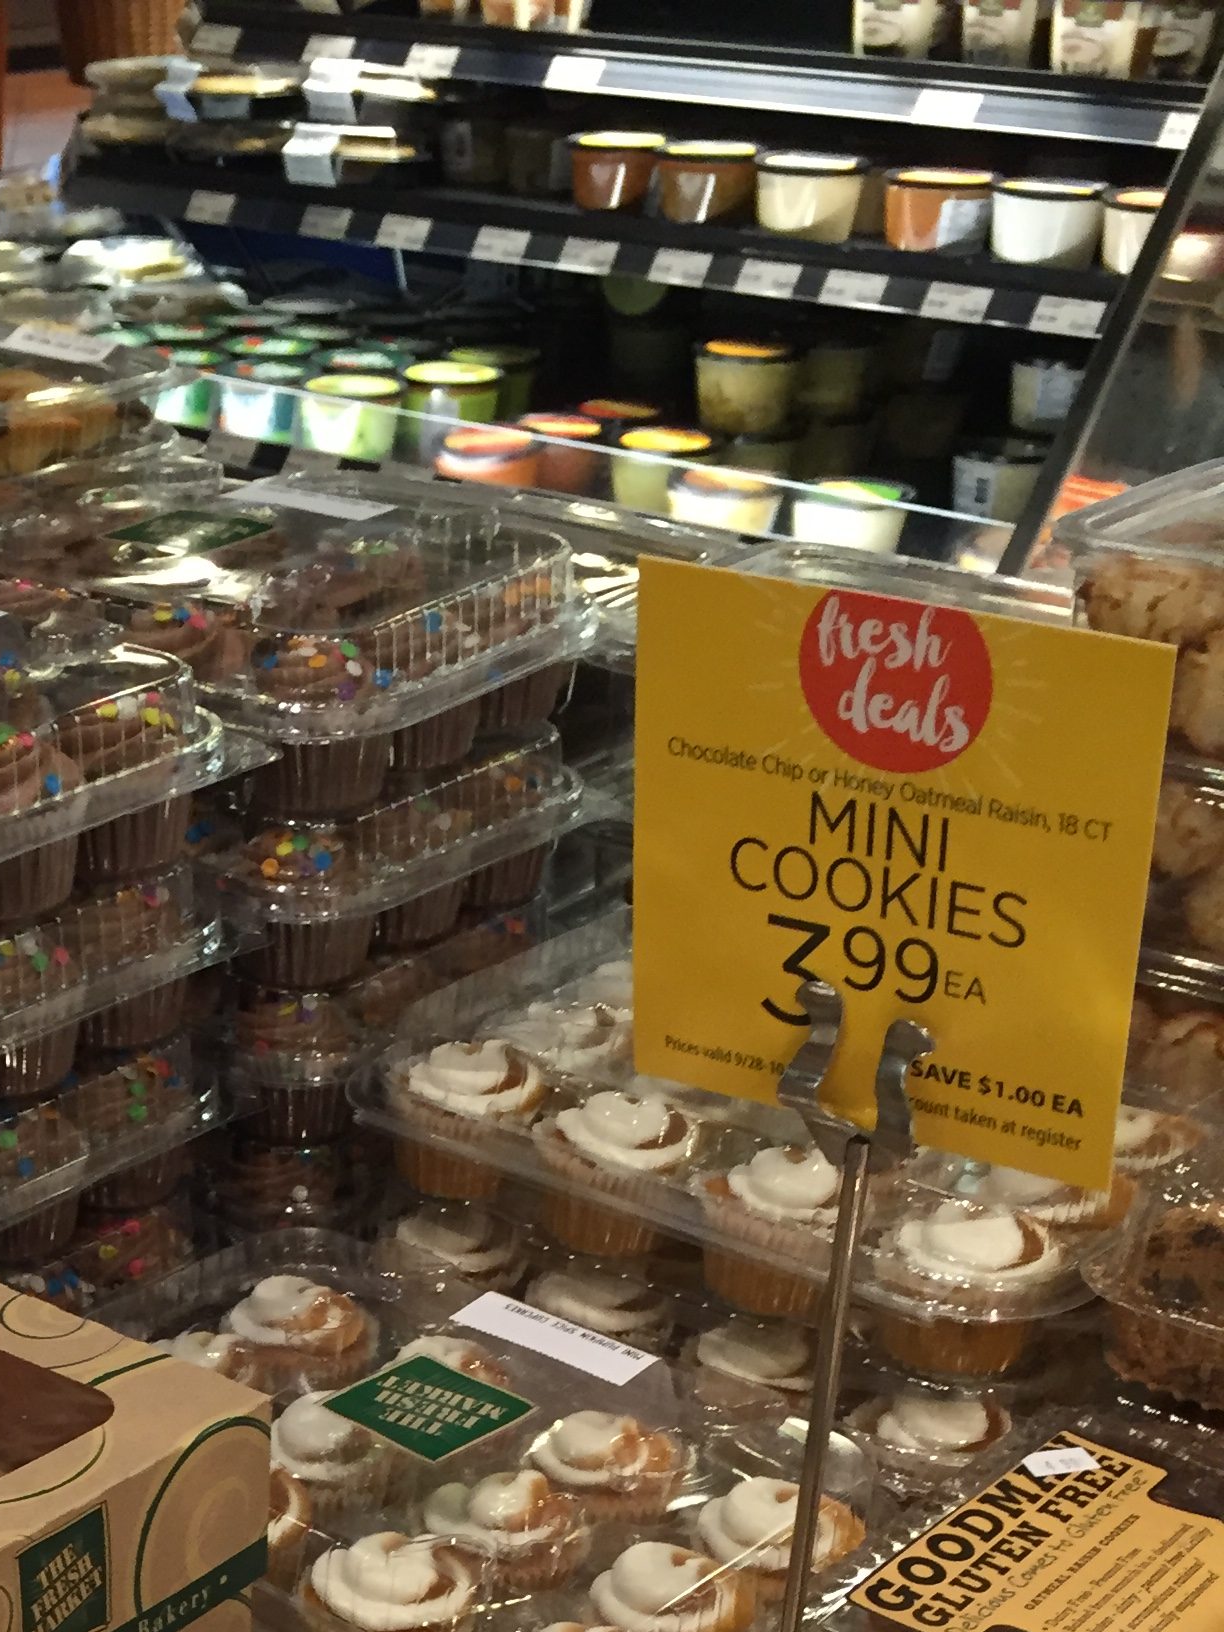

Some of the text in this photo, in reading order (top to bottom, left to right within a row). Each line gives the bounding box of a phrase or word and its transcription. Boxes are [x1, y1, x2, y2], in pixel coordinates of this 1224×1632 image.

[816, 594, 953, 671] fresh
[837, 656, 972, 754] deals
[667, 734, 758, 772] Chocolate
[761, 753, 804, 783] Chip
[808, 767, 829, 785] or
[833, 768, 894, 801] Honey
[899, 781, 983, 816] Oatmeal
[1058, 811, 1080, 835] 18
[1083, 818, 1113, 842] CT
[810, 791, 949, 872] MINI
[729, 836, 1029, 949] COOKIES
[944, 970, 987, 1006] EA
[664, 1034, 699, 1056] Prices
[703, 1046, 732, 1063] valid
[910, 1059, 1084, 1119] SAVE $1.00 EA
[954, 1105, 997, 1132] taken
[1000, 1119, 1016, 1136] at
[1020, 1124, 1082, 1151] register
[374, 1390, 481, 1430] FRESH
[376, 1375, 510, 1421] MARKET
[378, 1408, 444, 1437] THE
[36, 1543, 76, 1590] THE
[913, 1455, 1134, 1627] GLUTEN FREE
[30, 1552, 92, 1623] FRESH
[1007, 1552, 1059, 1590] Comes
